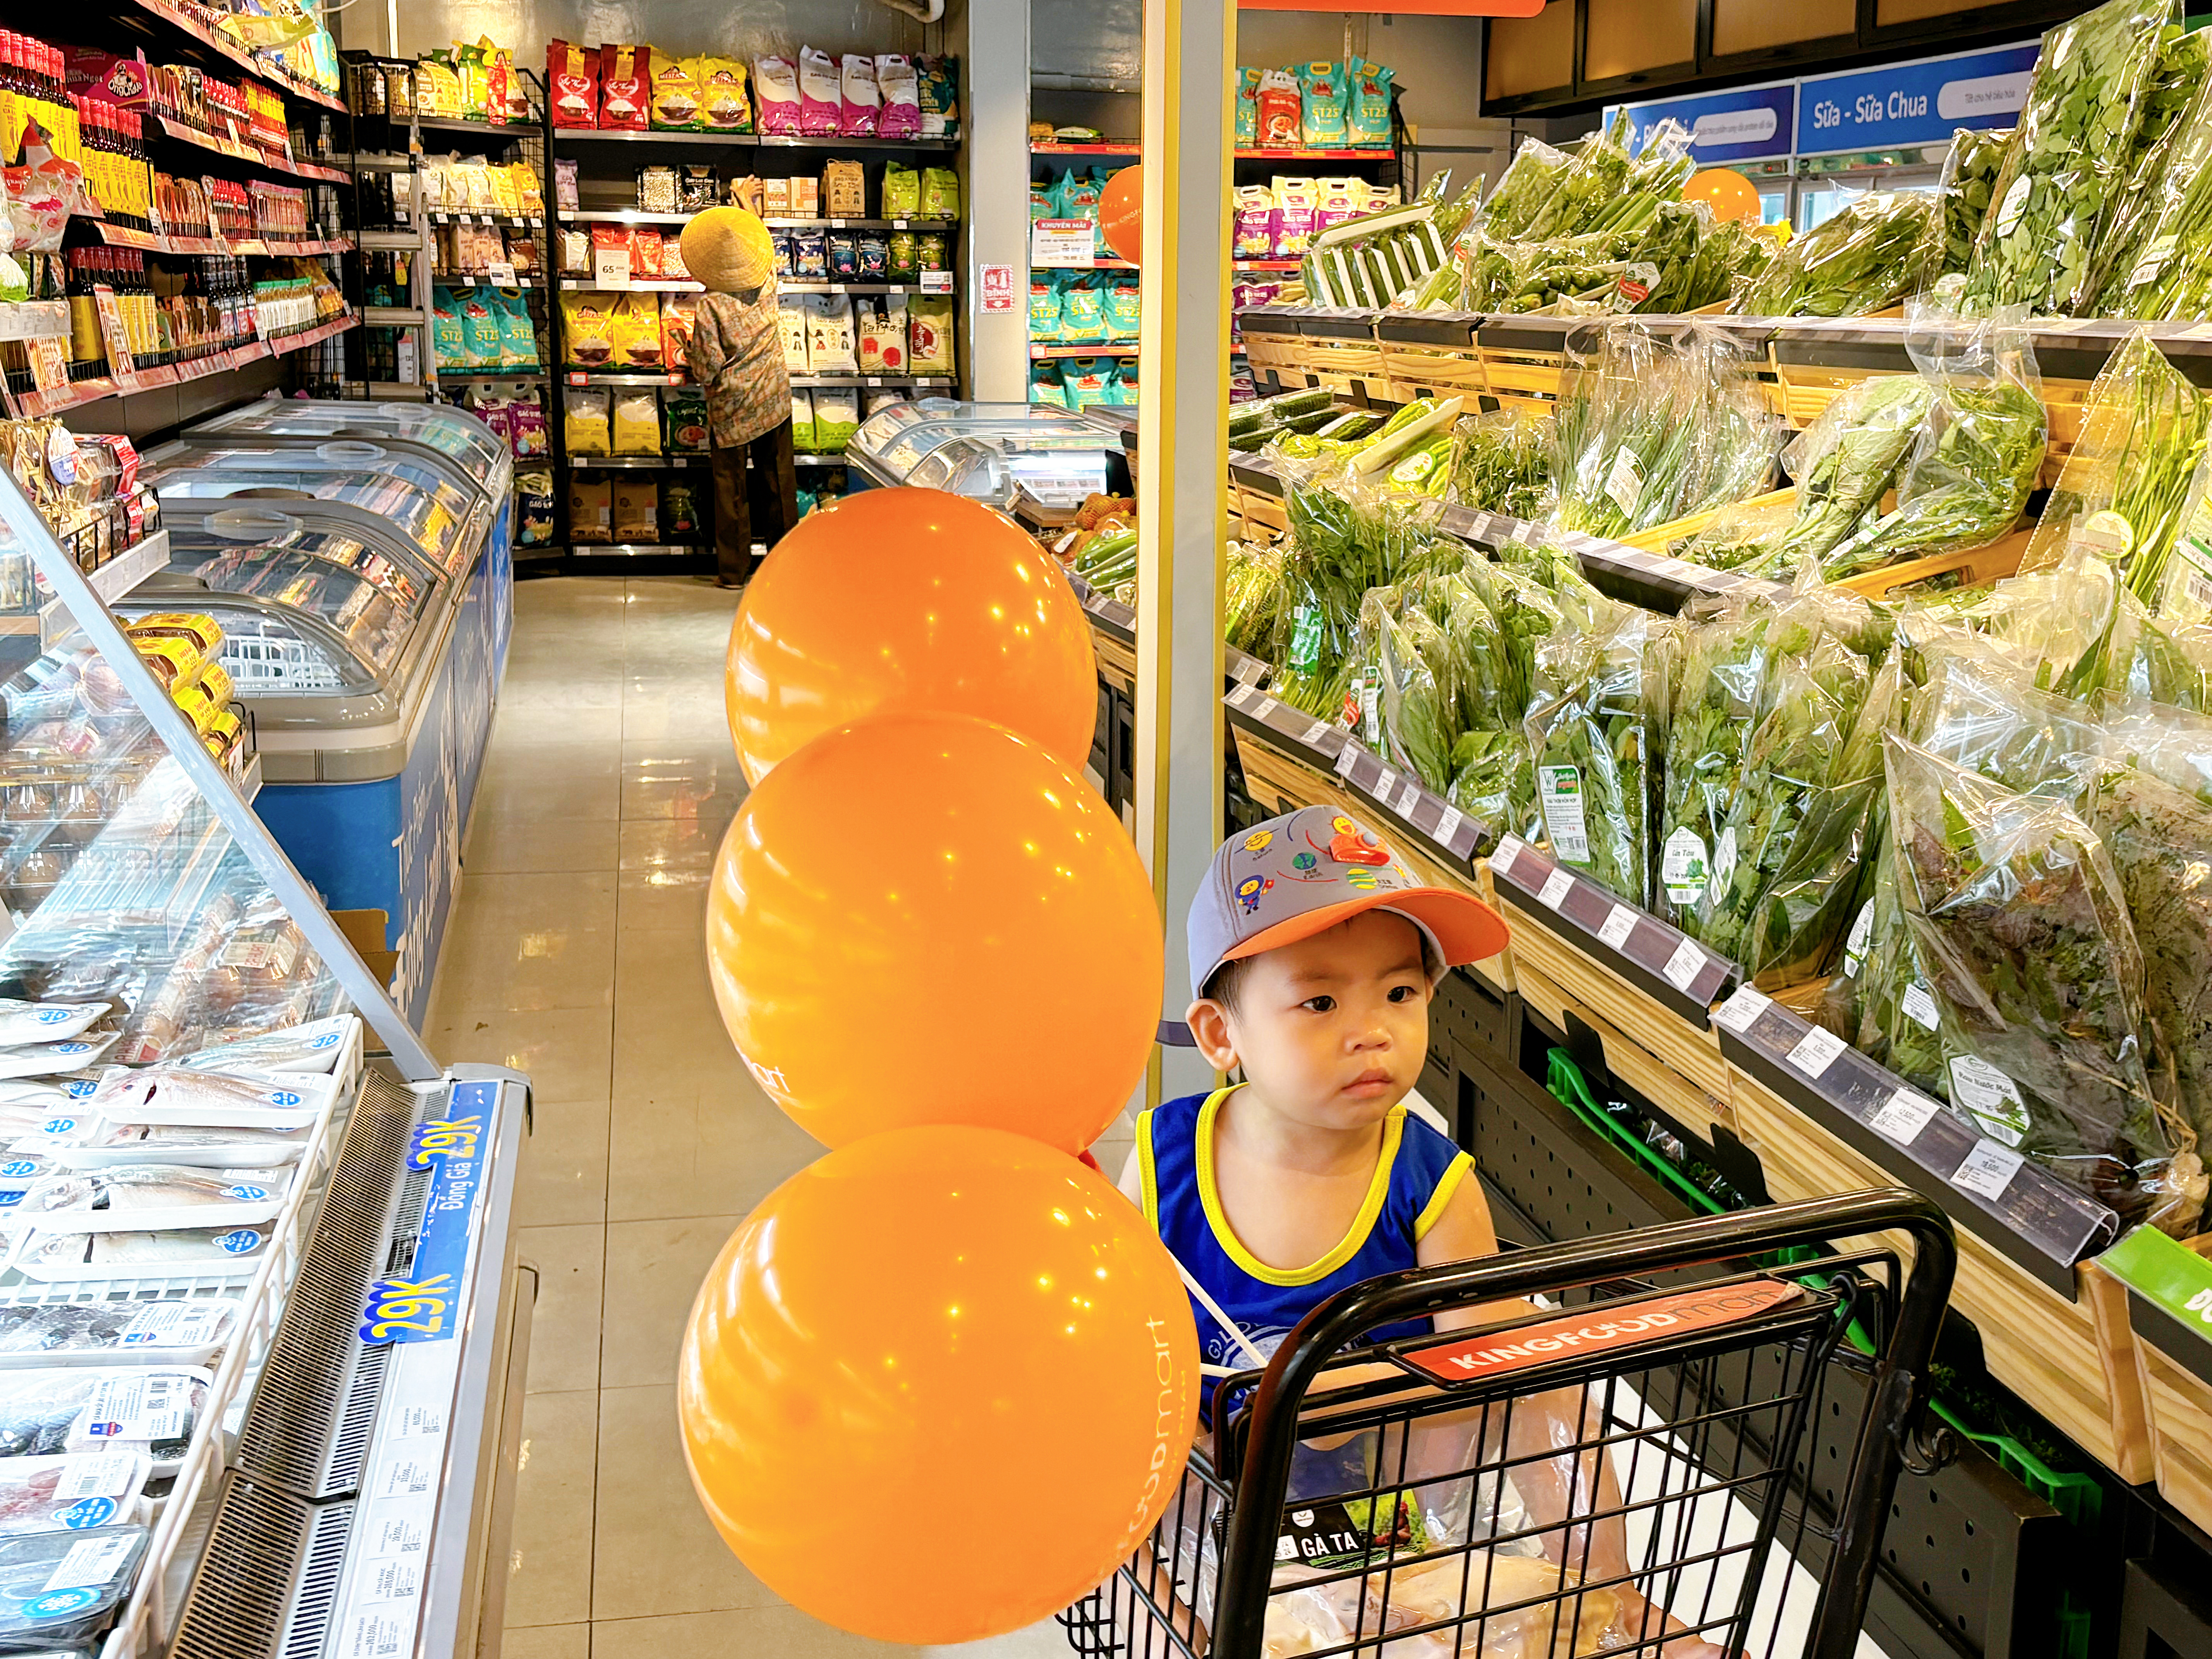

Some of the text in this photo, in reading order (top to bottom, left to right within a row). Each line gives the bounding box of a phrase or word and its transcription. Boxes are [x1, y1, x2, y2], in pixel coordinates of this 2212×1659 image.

[1312, 107, 1339, 118] ST25
[1361, 107, 1387, 118] ST25
[1814, 97, 1840, 129] Sữa
[1855, 93, 1883, 124] Sữa
[1887, 90, 1927, 118] Chua
[1031, 307, 1058, 318] ST25
[425, 811, 442, 945] Lạnh
[416, 1115, 482, 1165] 29K
[438, 1162, 475, 1211] Đồng Giá
[371, 1273, 451, 1338] 29K
[1447, 1286, 1781, 1370] KINGFOODmart
[1301, 1532, 1359, 1557] GÀ TA
